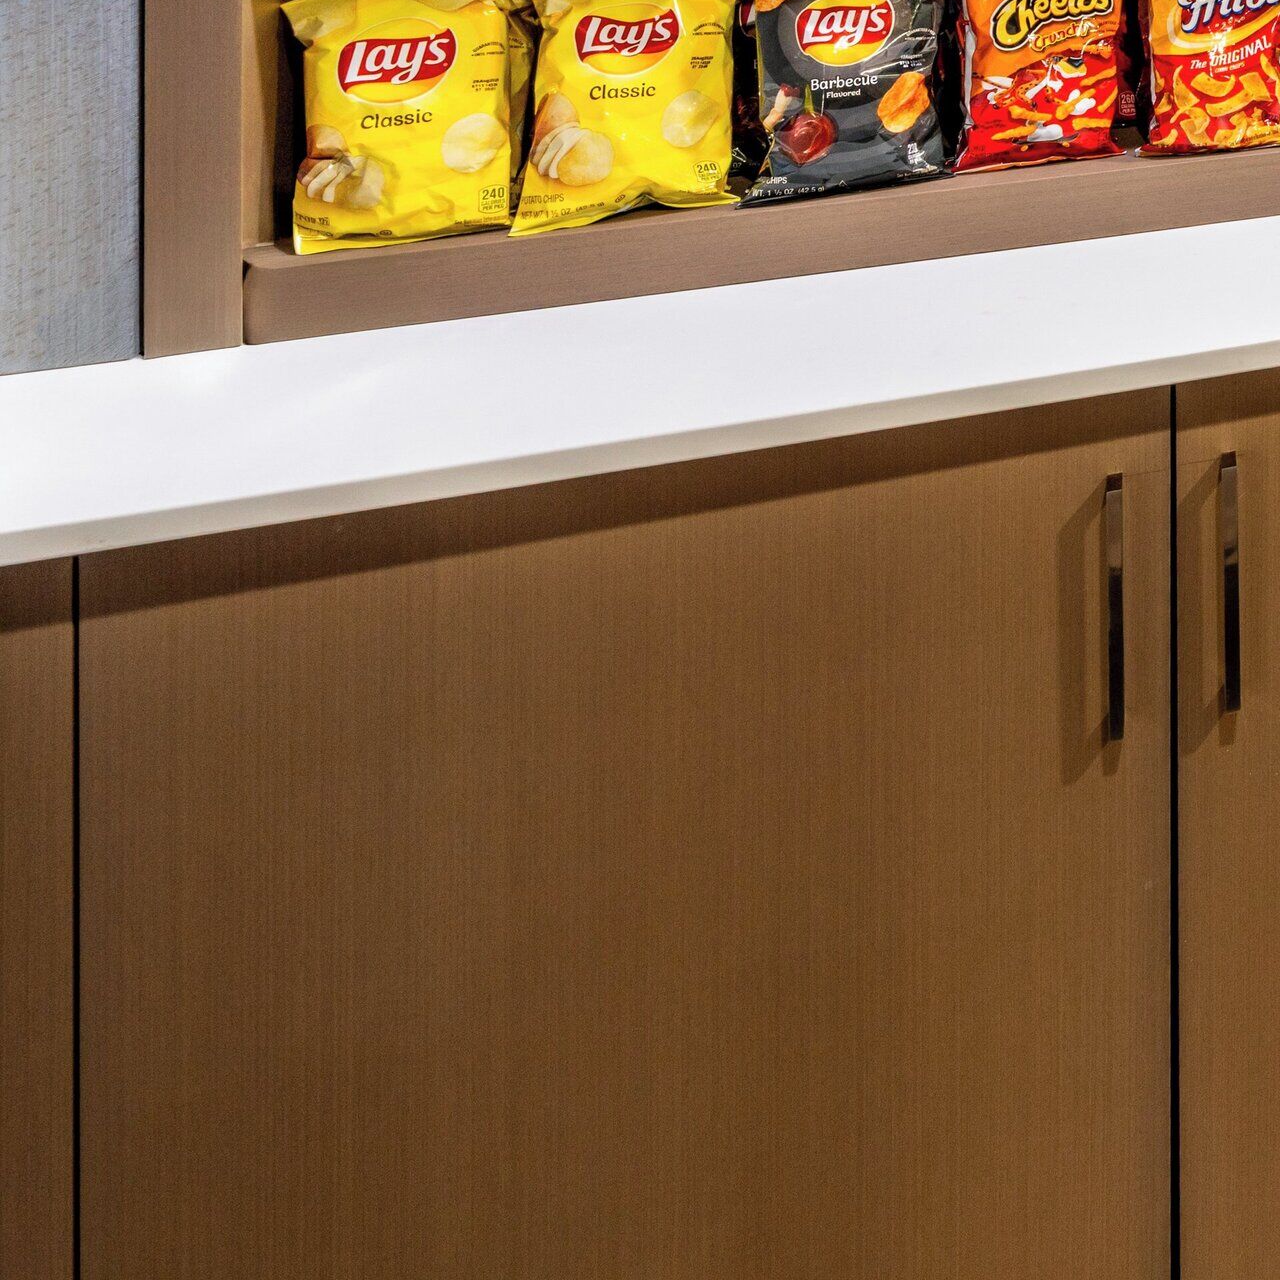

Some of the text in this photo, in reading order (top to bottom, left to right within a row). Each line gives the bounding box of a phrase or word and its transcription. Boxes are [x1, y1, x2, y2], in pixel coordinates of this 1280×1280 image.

[803, 3, 888, 47] Lay's
[582, 15, 673, 56] Lay's
[345, 33, 450, 85] Lay's
[1190, 34, 1272, 70] The ORIGINAL
[589, 83, 656, 101] Classic
[810, 75, 878, 91] Barbecue
[826, 89, 861, 99] Flavored
[360, 109, 433, 130] Classic
[696, 163, 717, 174] 240
[482, 187, 505, 200] 240
[542, 193, 564, 203] CHIPS
